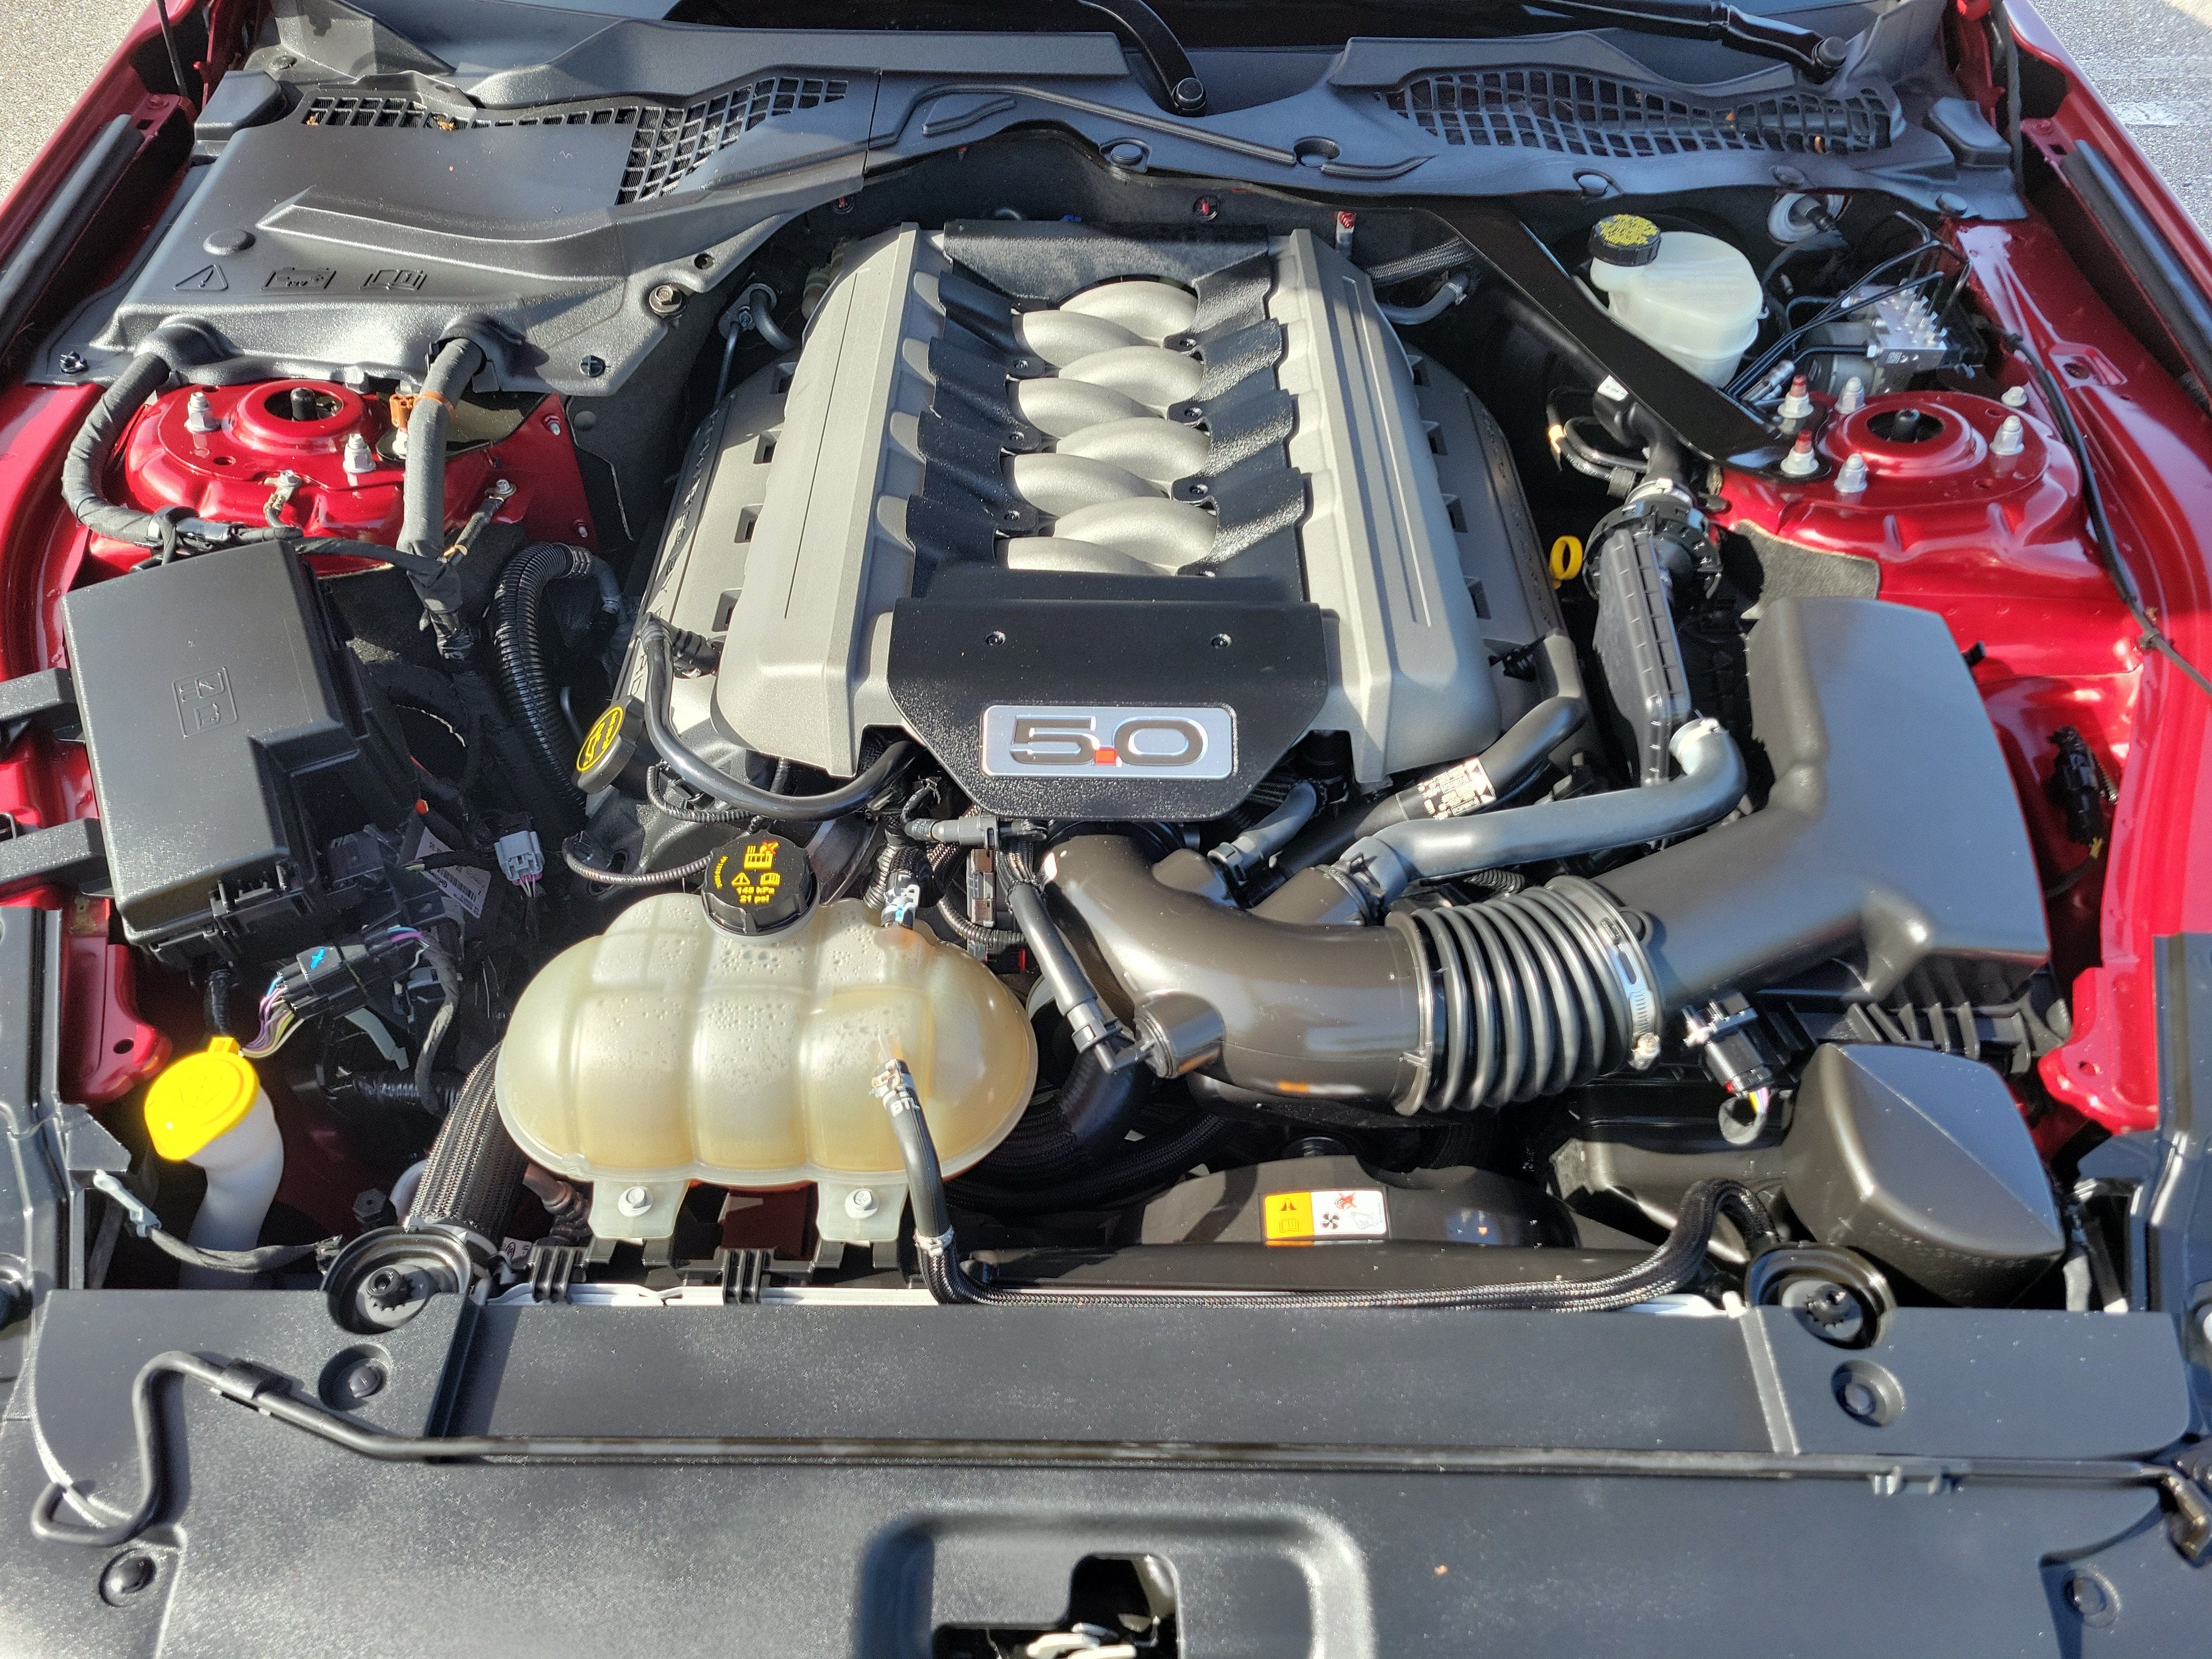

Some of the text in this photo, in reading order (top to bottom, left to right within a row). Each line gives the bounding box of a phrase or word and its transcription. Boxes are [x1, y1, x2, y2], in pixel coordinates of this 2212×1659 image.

[660, 549, 680, 593] BY
[1009, 714, 1209, 766] 5.0
[736, 887, 775, 895] 145 kPa
[754, 895, 770, 904] psi
